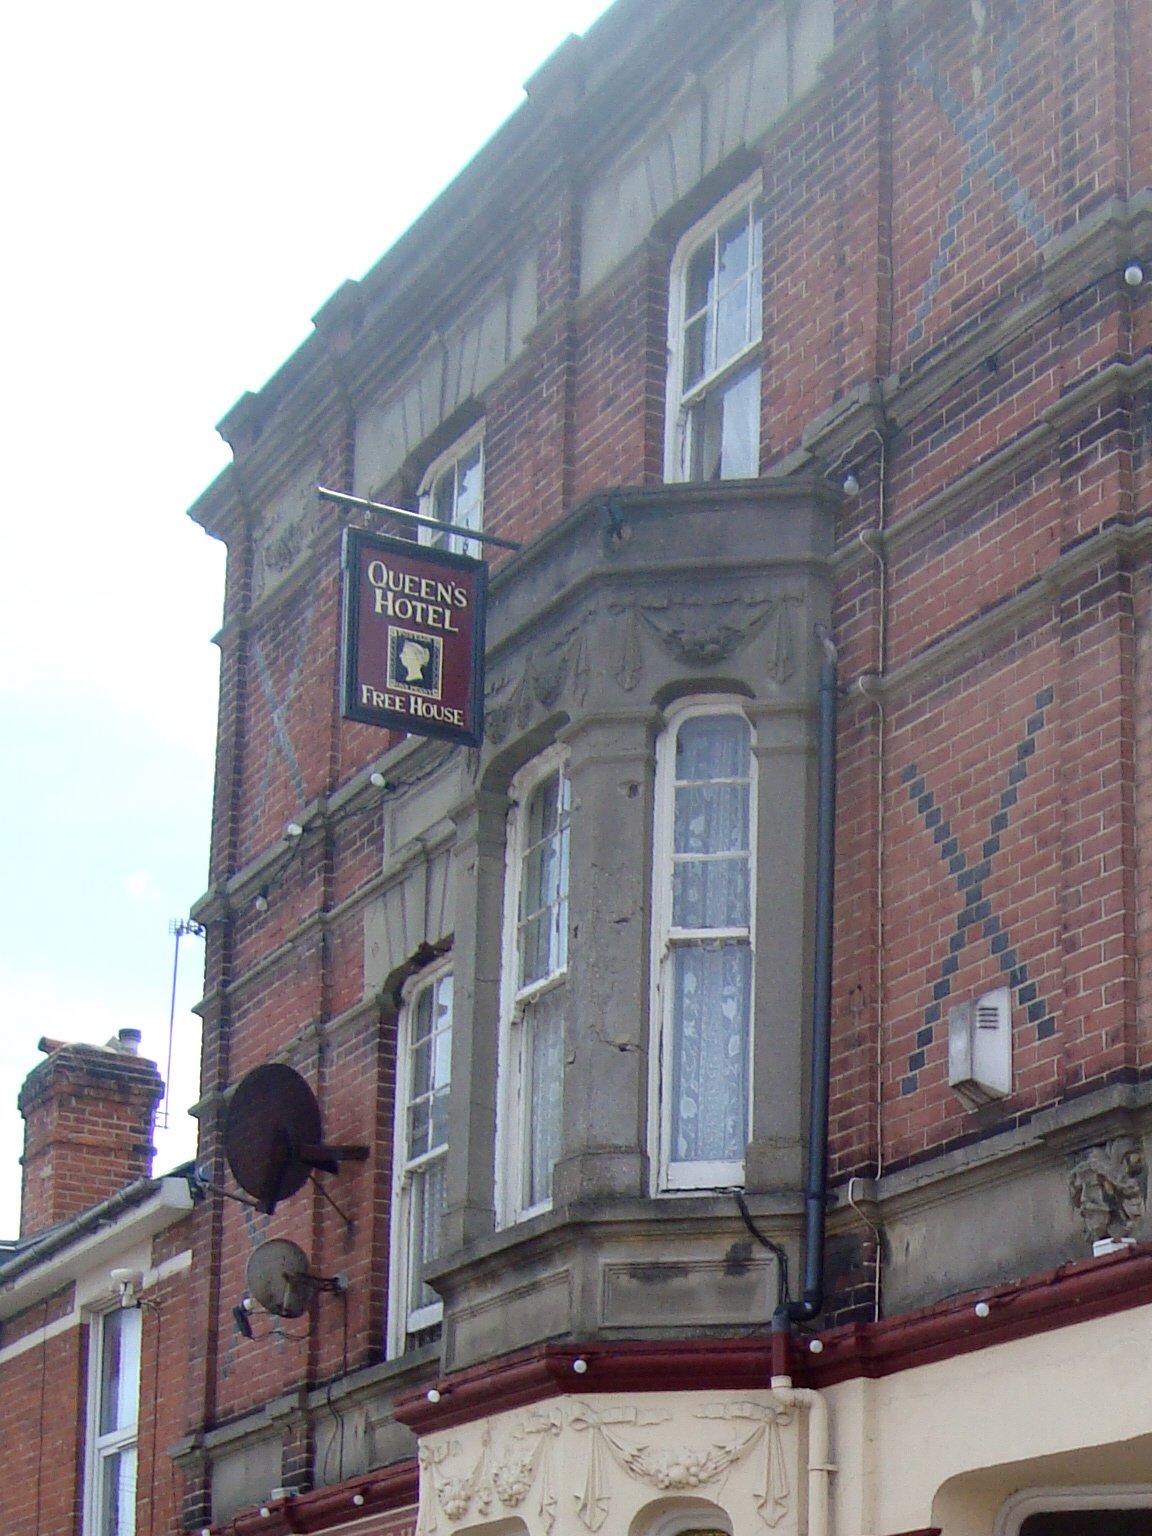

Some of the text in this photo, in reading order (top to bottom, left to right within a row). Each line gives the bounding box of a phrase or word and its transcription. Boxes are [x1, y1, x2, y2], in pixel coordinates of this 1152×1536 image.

[368, 560, 468, 607] QUEEN'S
[374, 588, 460, 633] HOTEL
[361, 684, 407, 713] FREE
[409, 694, 465, 727] HOUSE
